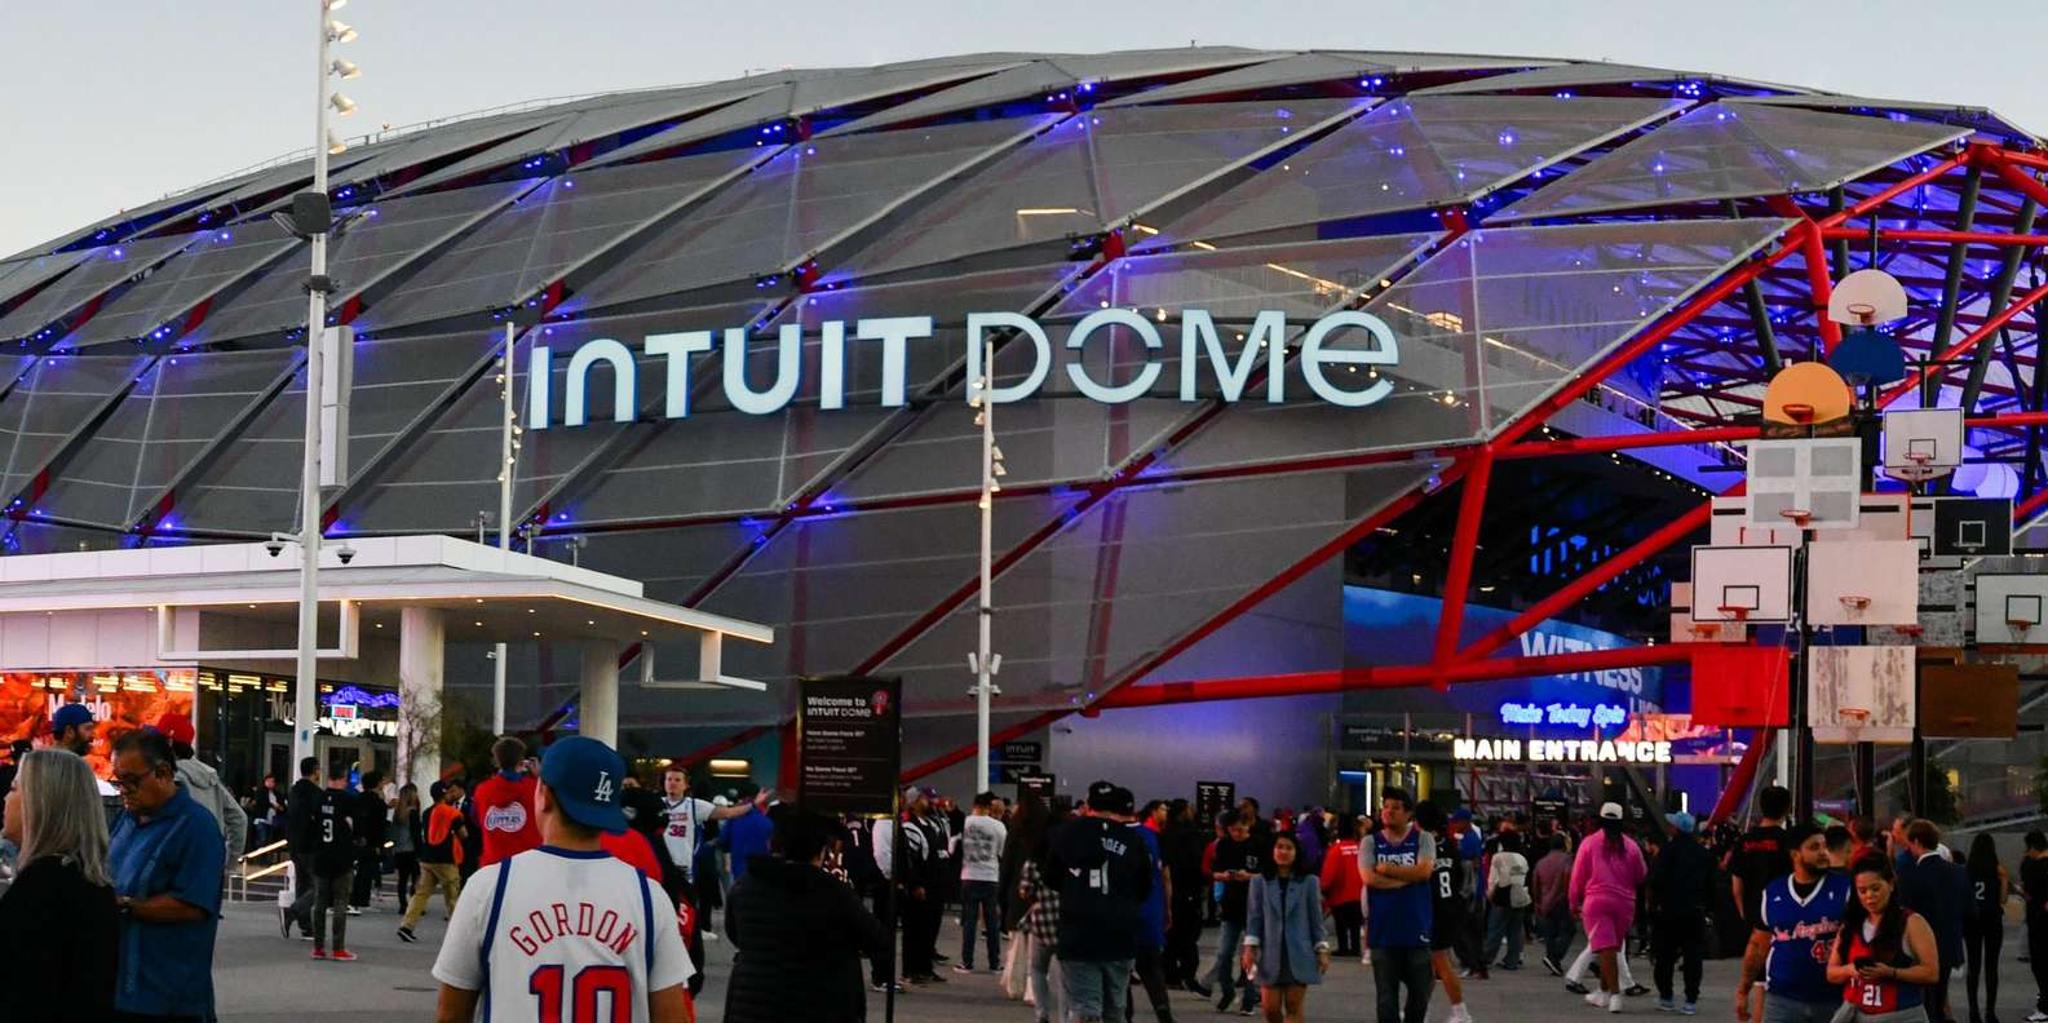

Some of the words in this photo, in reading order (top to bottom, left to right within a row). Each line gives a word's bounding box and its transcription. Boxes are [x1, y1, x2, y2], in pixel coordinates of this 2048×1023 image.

[530, 316, 933, 430] INTUIT
[967, 308, 1399, 407] DOME
[48, 694, 112, 721] Melo
[807, 697, 853, 706] Welcome
[855, 698, 866, 707] to
[807, 708, 839, 716] INTUIT
[841, 708, 872, 717] DOME
[1546, 703, 1592, 728] Today
[1454, 738, 1521, 760] MAIN
[1529, 740, 1672, 762] ENTRANCE
[594, 770, 614, 802] LA
[322, 819, 333, 842] 3
[1439, 871, 1452, 898] 8
[1974, 881, 1986, 900] 2
[509, 902, 639, 957] GORDON
[528, 964, 633, 1023] 10
[1861, 983, 1883, 1008] 21
